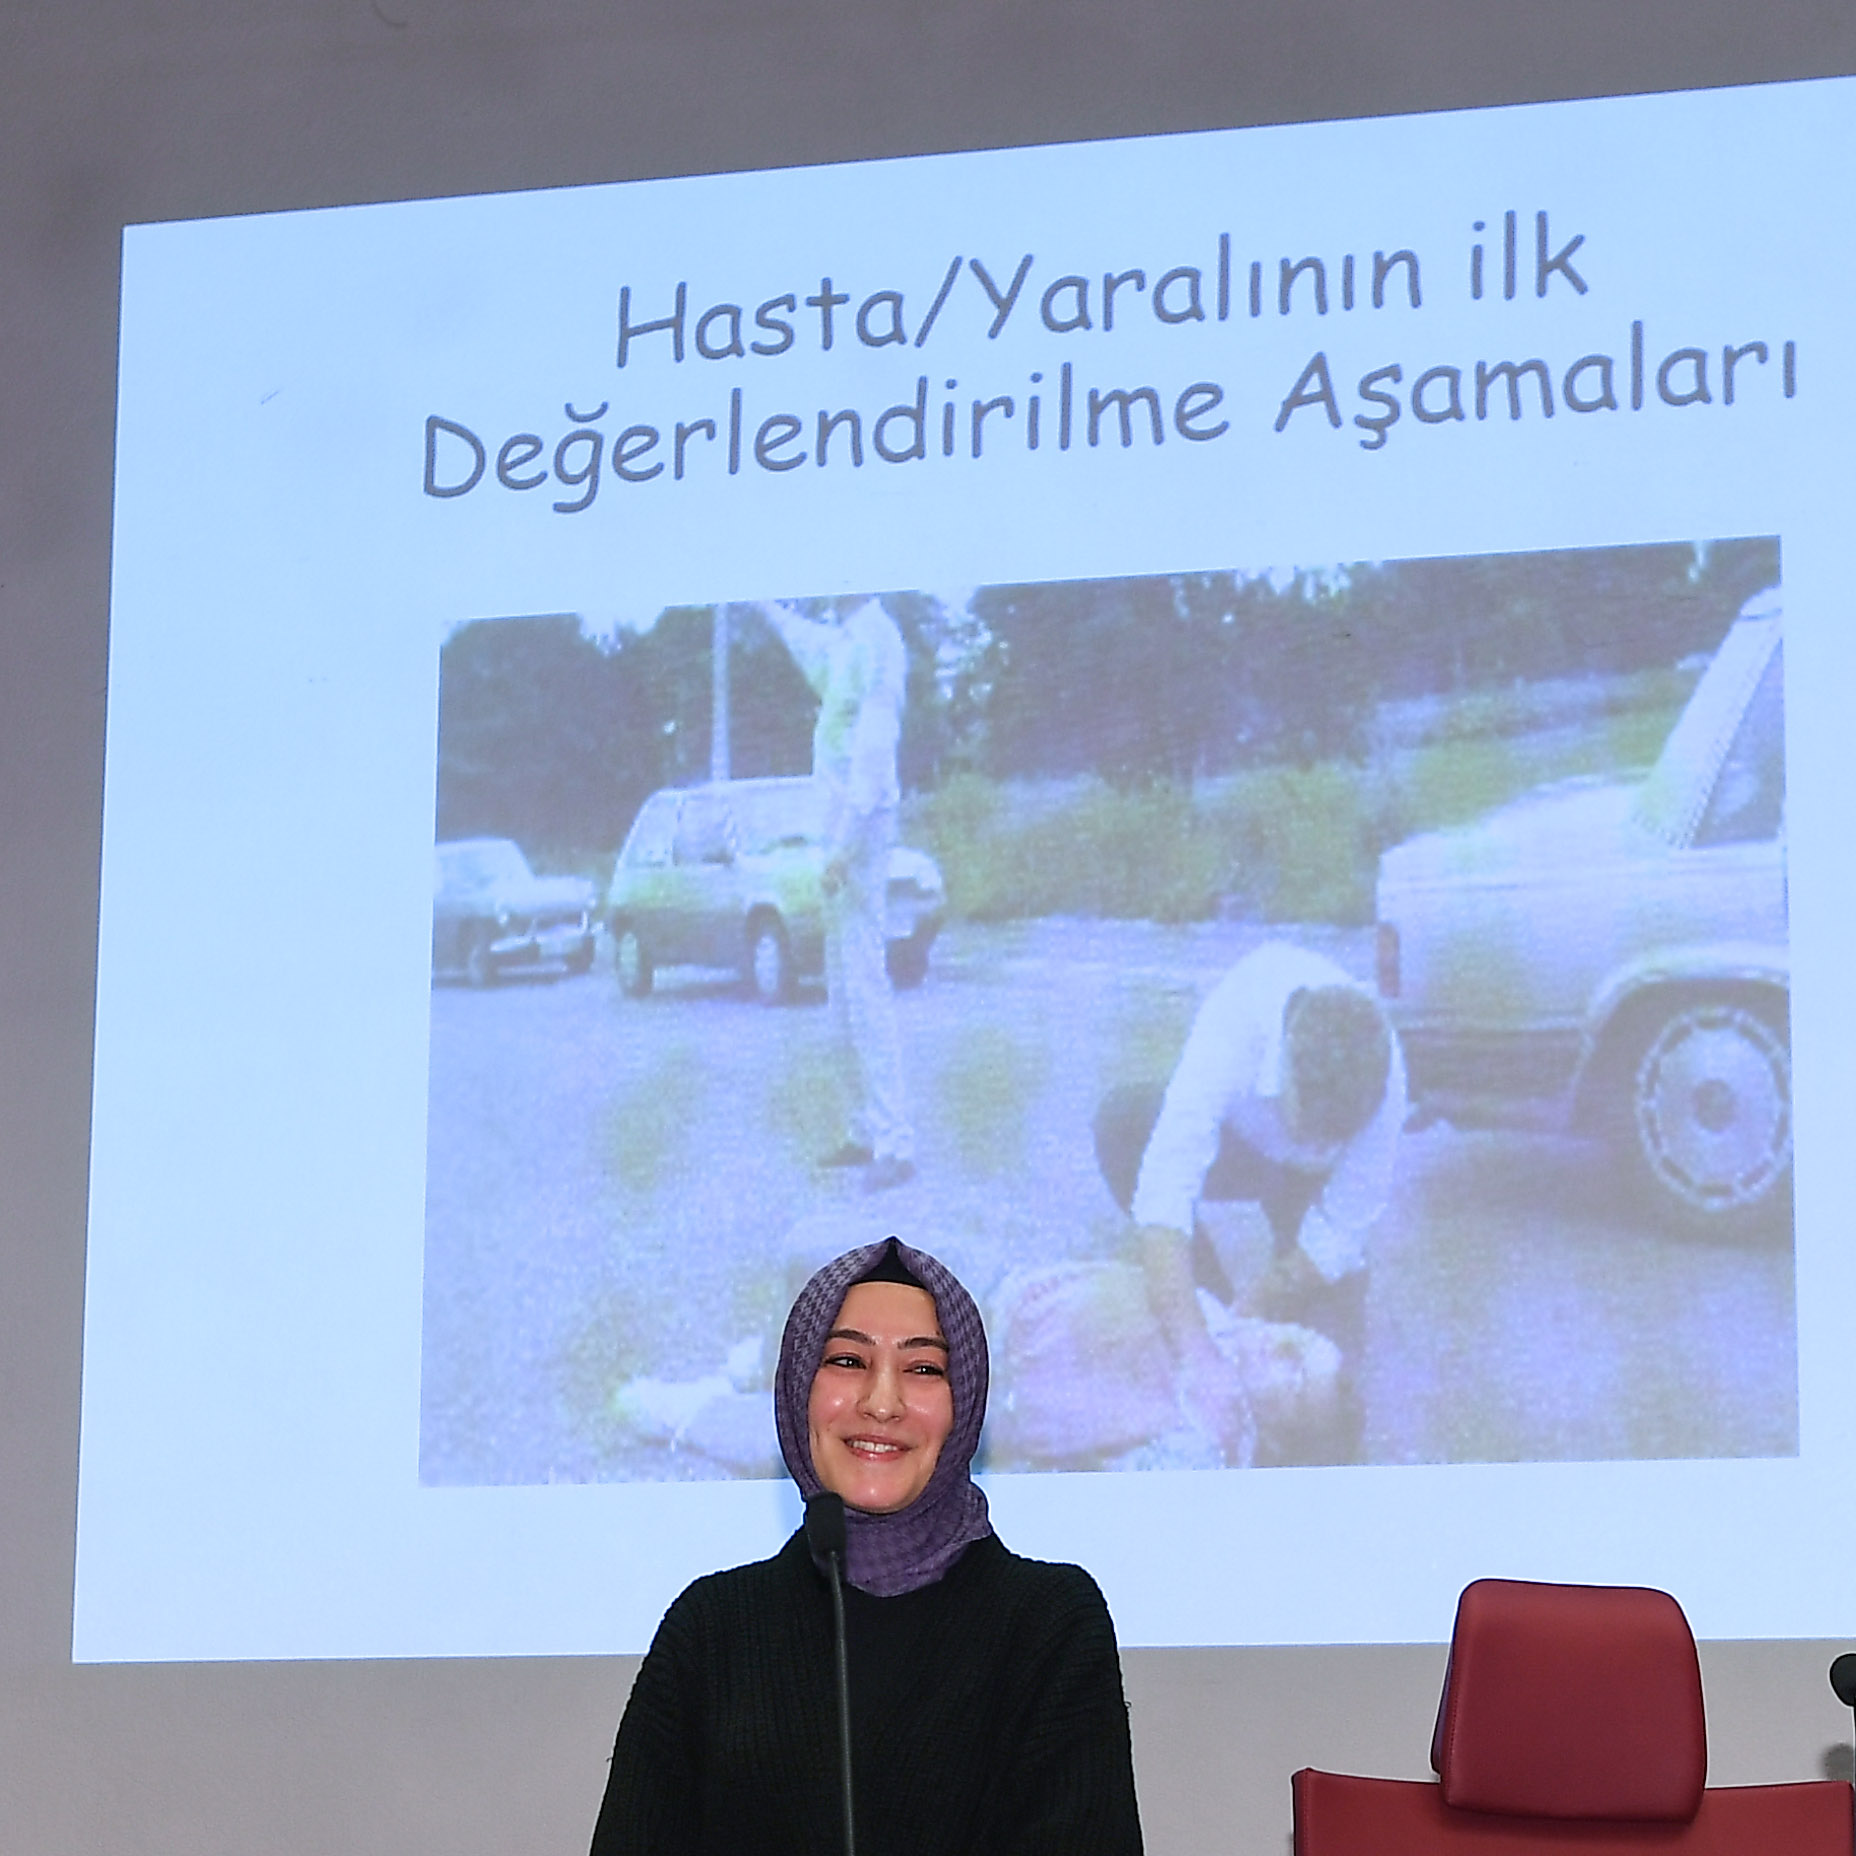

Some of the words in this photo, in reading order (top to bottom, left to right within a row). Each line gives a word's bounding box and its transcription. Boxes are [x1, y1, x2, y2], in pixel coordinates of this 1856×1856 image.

[615, 231, 1423, 370] Hasta/Yaralının
[1470, 209, 1590, 302] ilk
[423, 361, 1231, 515] Değerlendirilme
[1273, 319, 1798, 451] Aşamaları
